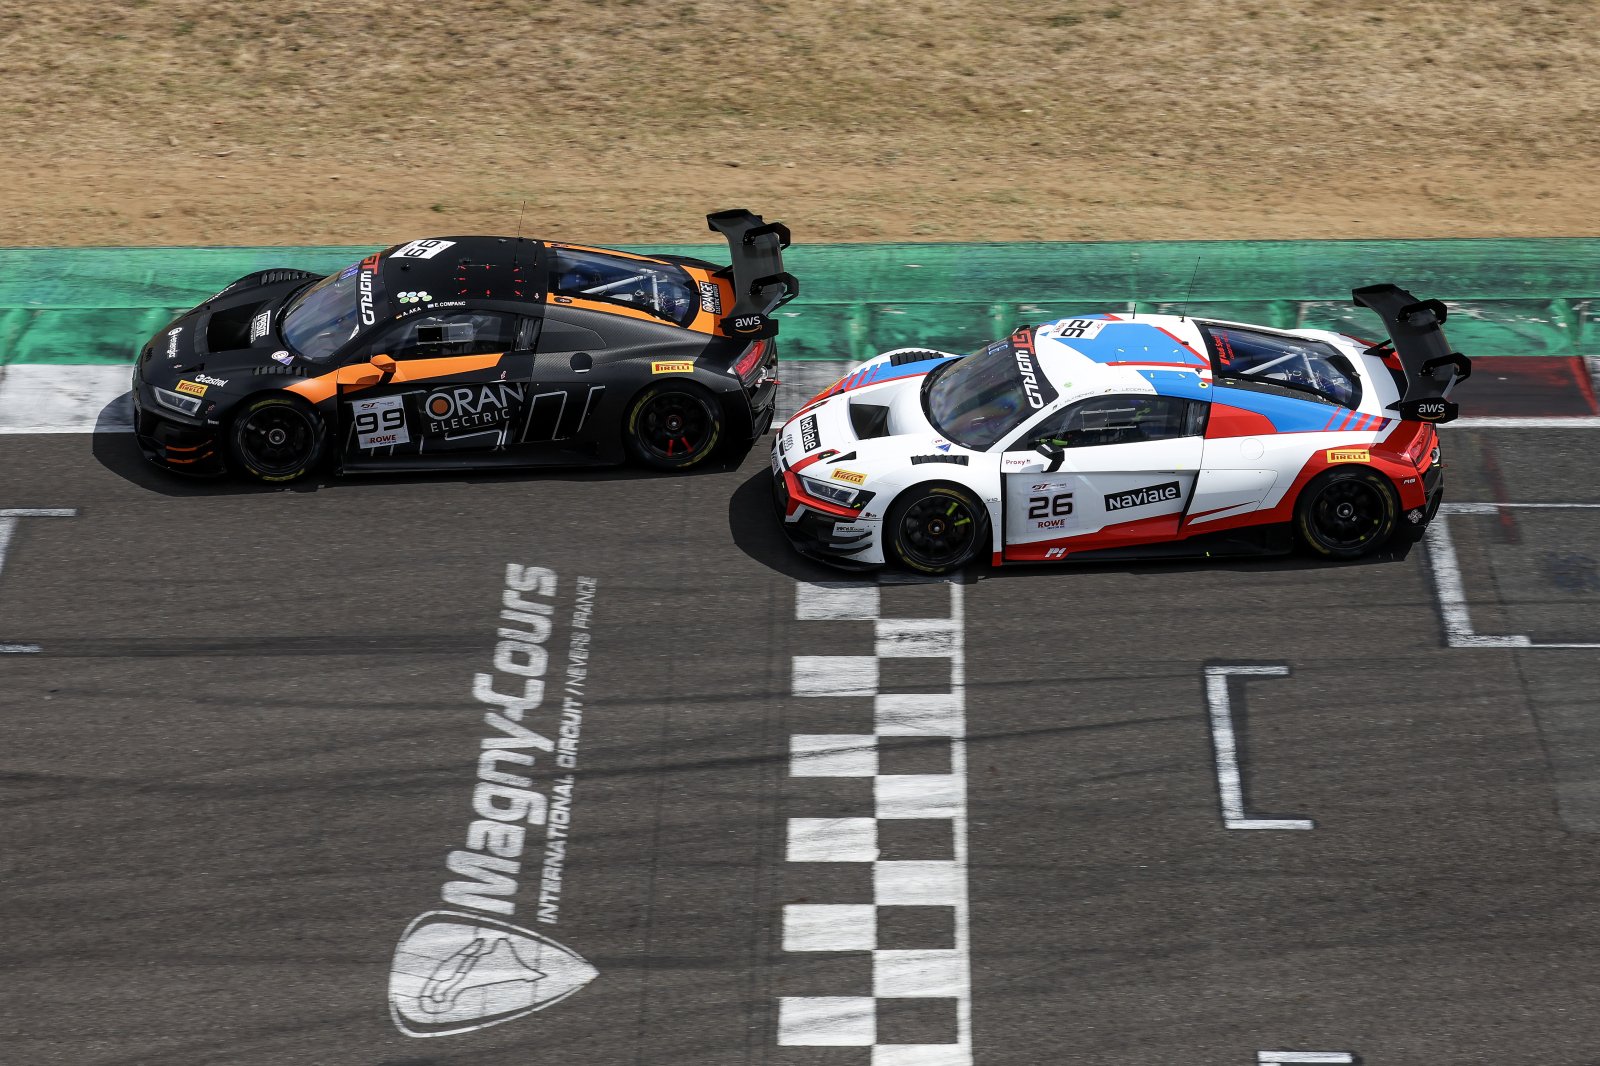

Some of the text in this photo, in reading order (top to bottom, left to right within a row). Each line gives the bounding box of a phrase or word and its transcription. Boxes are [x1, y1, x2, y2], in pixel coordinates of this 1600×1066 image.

[359, 271, 376, 326] WORLD
[409, 306, 422, 314] AKA
[735, 315, 761, 328] aws
[1061, 319, 1094, 338] 26
[655, 362, 691, 372] PIRELLI
[1012, 330, 1044, 409] GT WORLD
[178, 381, 204, 395] PIRELLI
[202, 375, 229, 388] Castrol
[1418, 402, 1445, 414] aws
[355, 408, 406, 435] 99
[430, 408, 510, 433] ELECTRIC
[369, 434, 397, 444] ROWE
[1331, 451, 1368, 461] PIRELLI
[833, 470, 865, 483] PIRELLI
[1028, 492, 1073, 519] 26
[1038, 519, 1065, 529] ROWE
[572, 576, 597, 629] FRANCE
[565, 632, 591, 687] NEVERS
[556, 697, 583, 768] CIRCUIT
[536, 775, 574, 925] INTERNATIONAL
